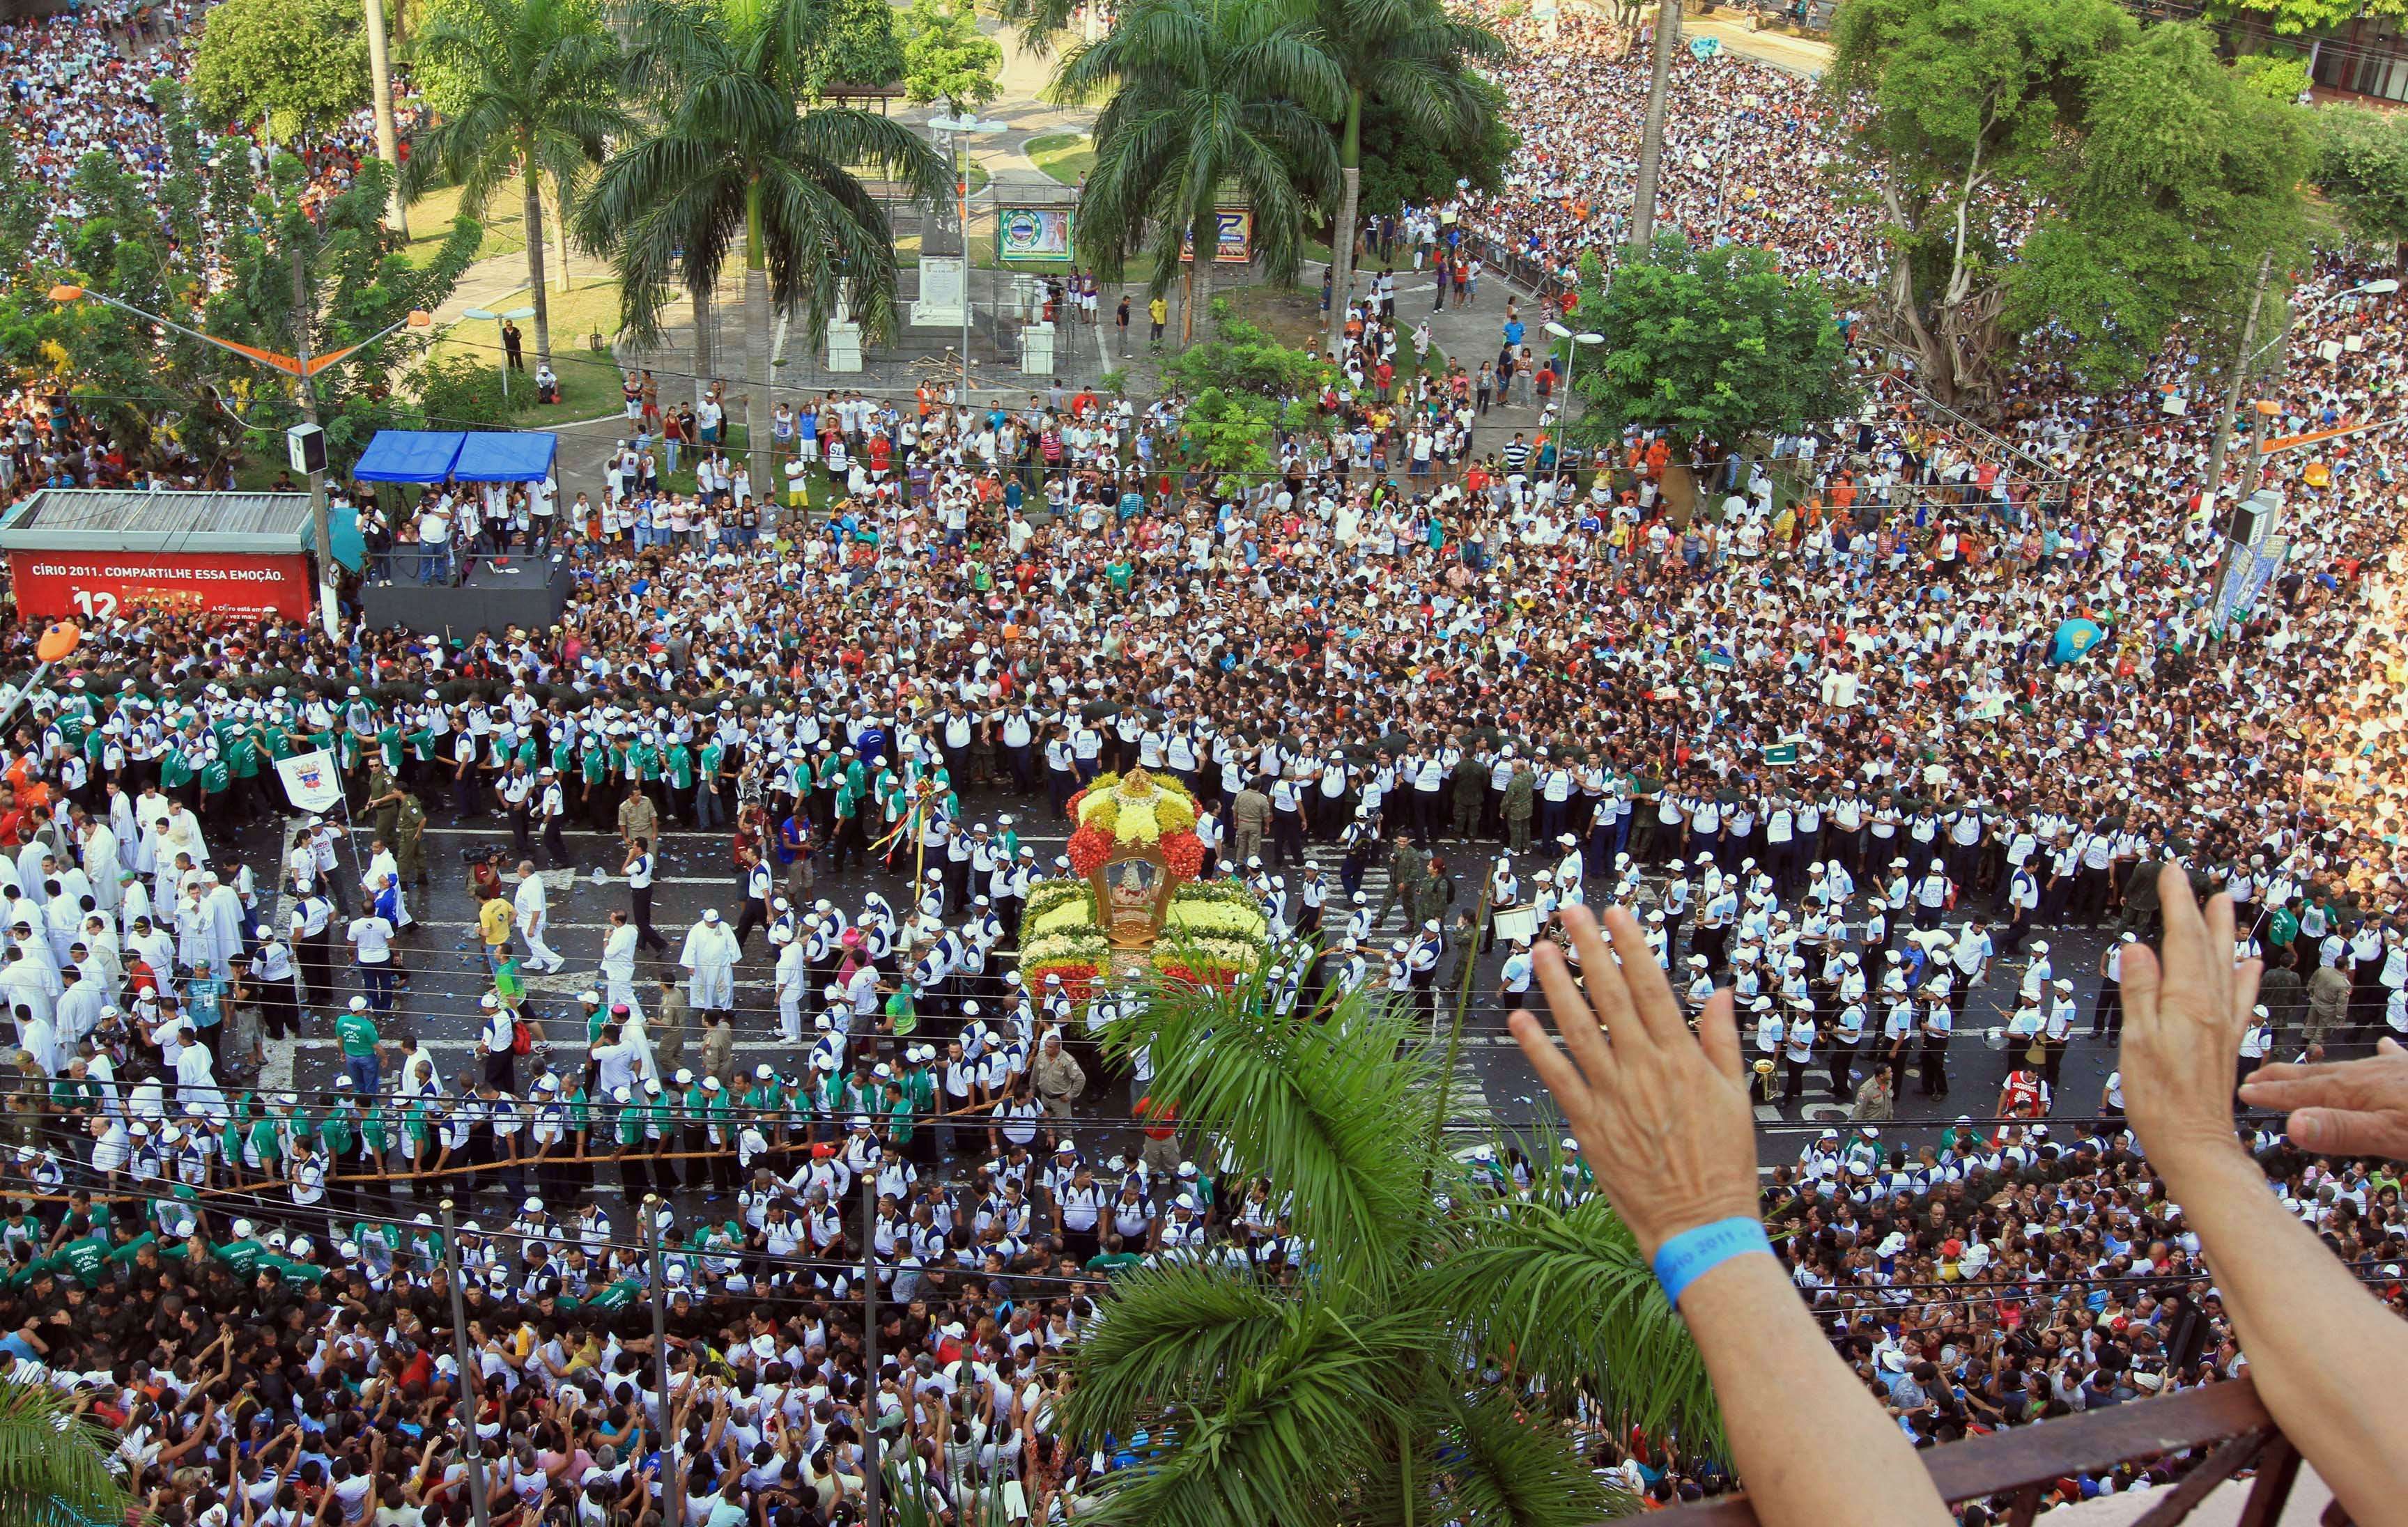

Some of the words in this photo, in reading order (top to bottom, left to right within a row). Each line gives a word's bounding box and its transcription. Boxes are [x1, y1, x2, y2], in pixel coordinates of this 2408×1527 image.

[831, 446, 841, 455] 51
[33, 563, 66, 575] CÍRIO
[70, 566, 102, 577] 2011.
[105, 567, 192, 579] COMPARTILHE
[195, 569, 227, 580] ESSA
[230, 568, 285, 582] EMOÇÃO.
[73, 591, 117, 622] 12
[75, 1255, 98, 1268] GUARDA
[233, 1257, 252, 1269] GUARD
[81, 1263, 98, 1273] APOIO
